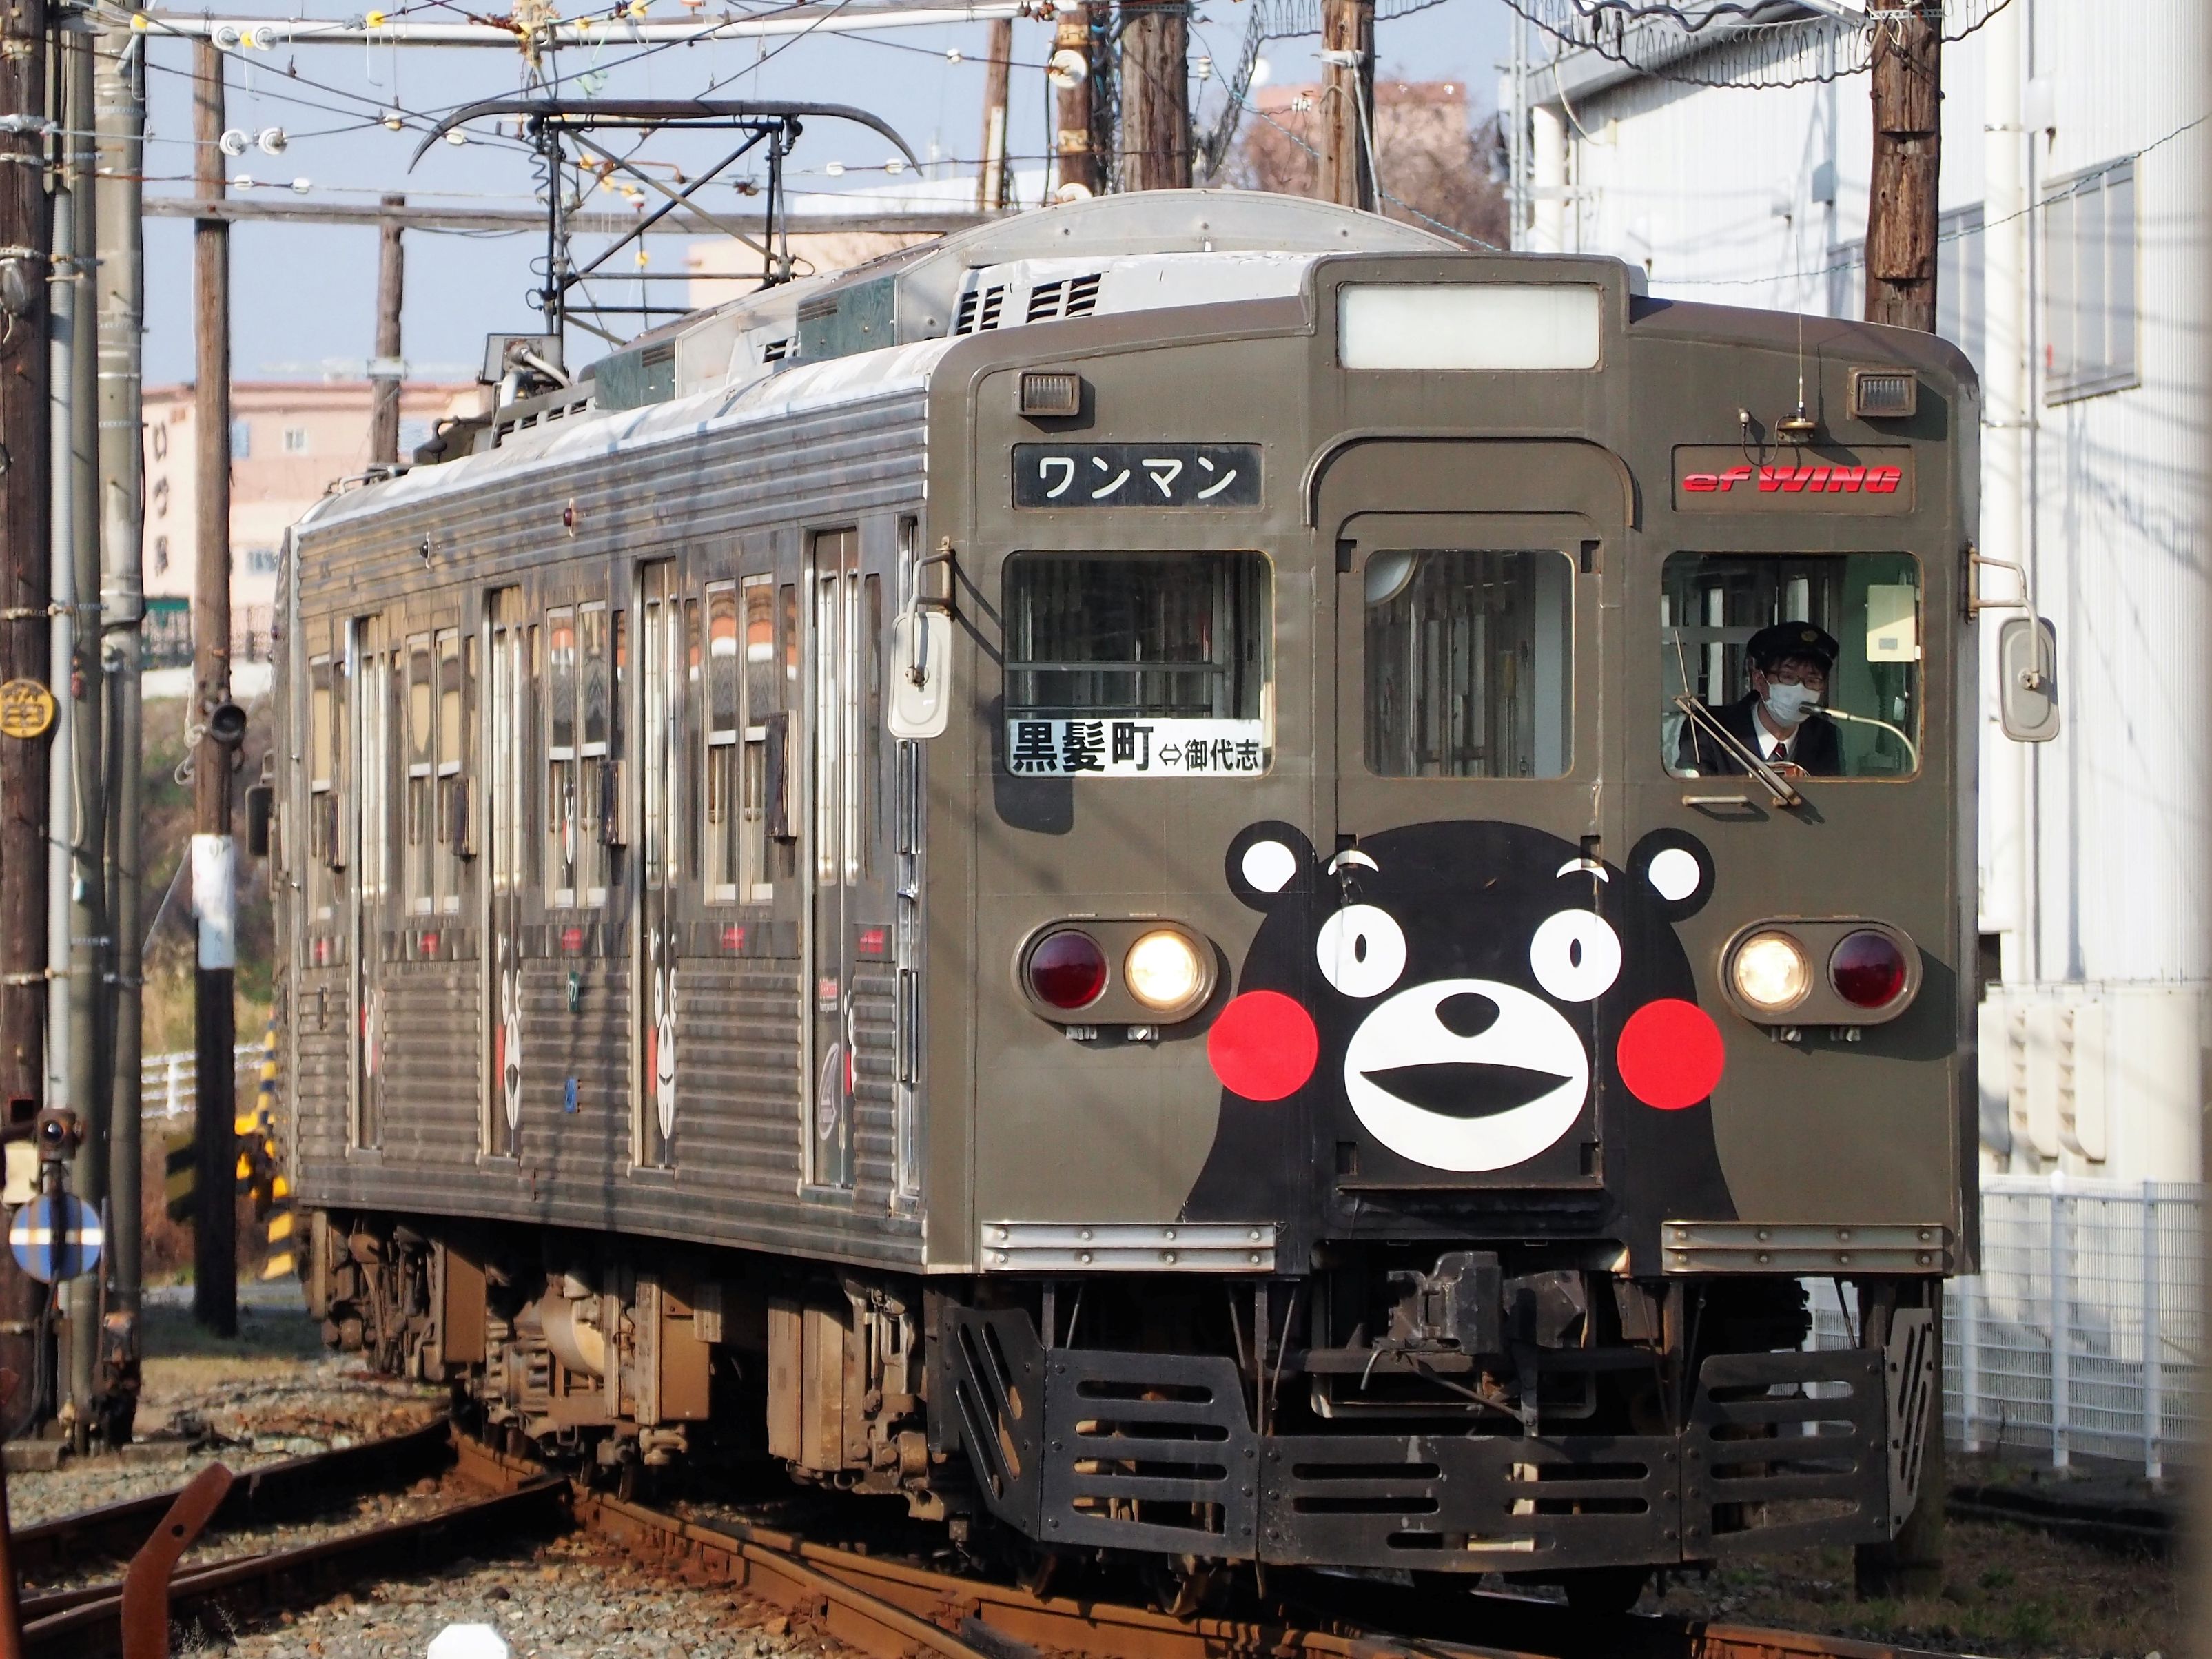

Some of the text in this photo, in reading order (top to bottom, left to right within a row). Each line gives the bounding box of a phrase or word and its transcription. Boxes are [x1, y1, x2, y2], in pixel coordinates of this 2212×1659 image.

[1039, 456, 1237, 499] ワンマン
[1683, 466, 1902, 493] ef WING
[1013, 721, 1259, 772] 黒髪町 御代志
